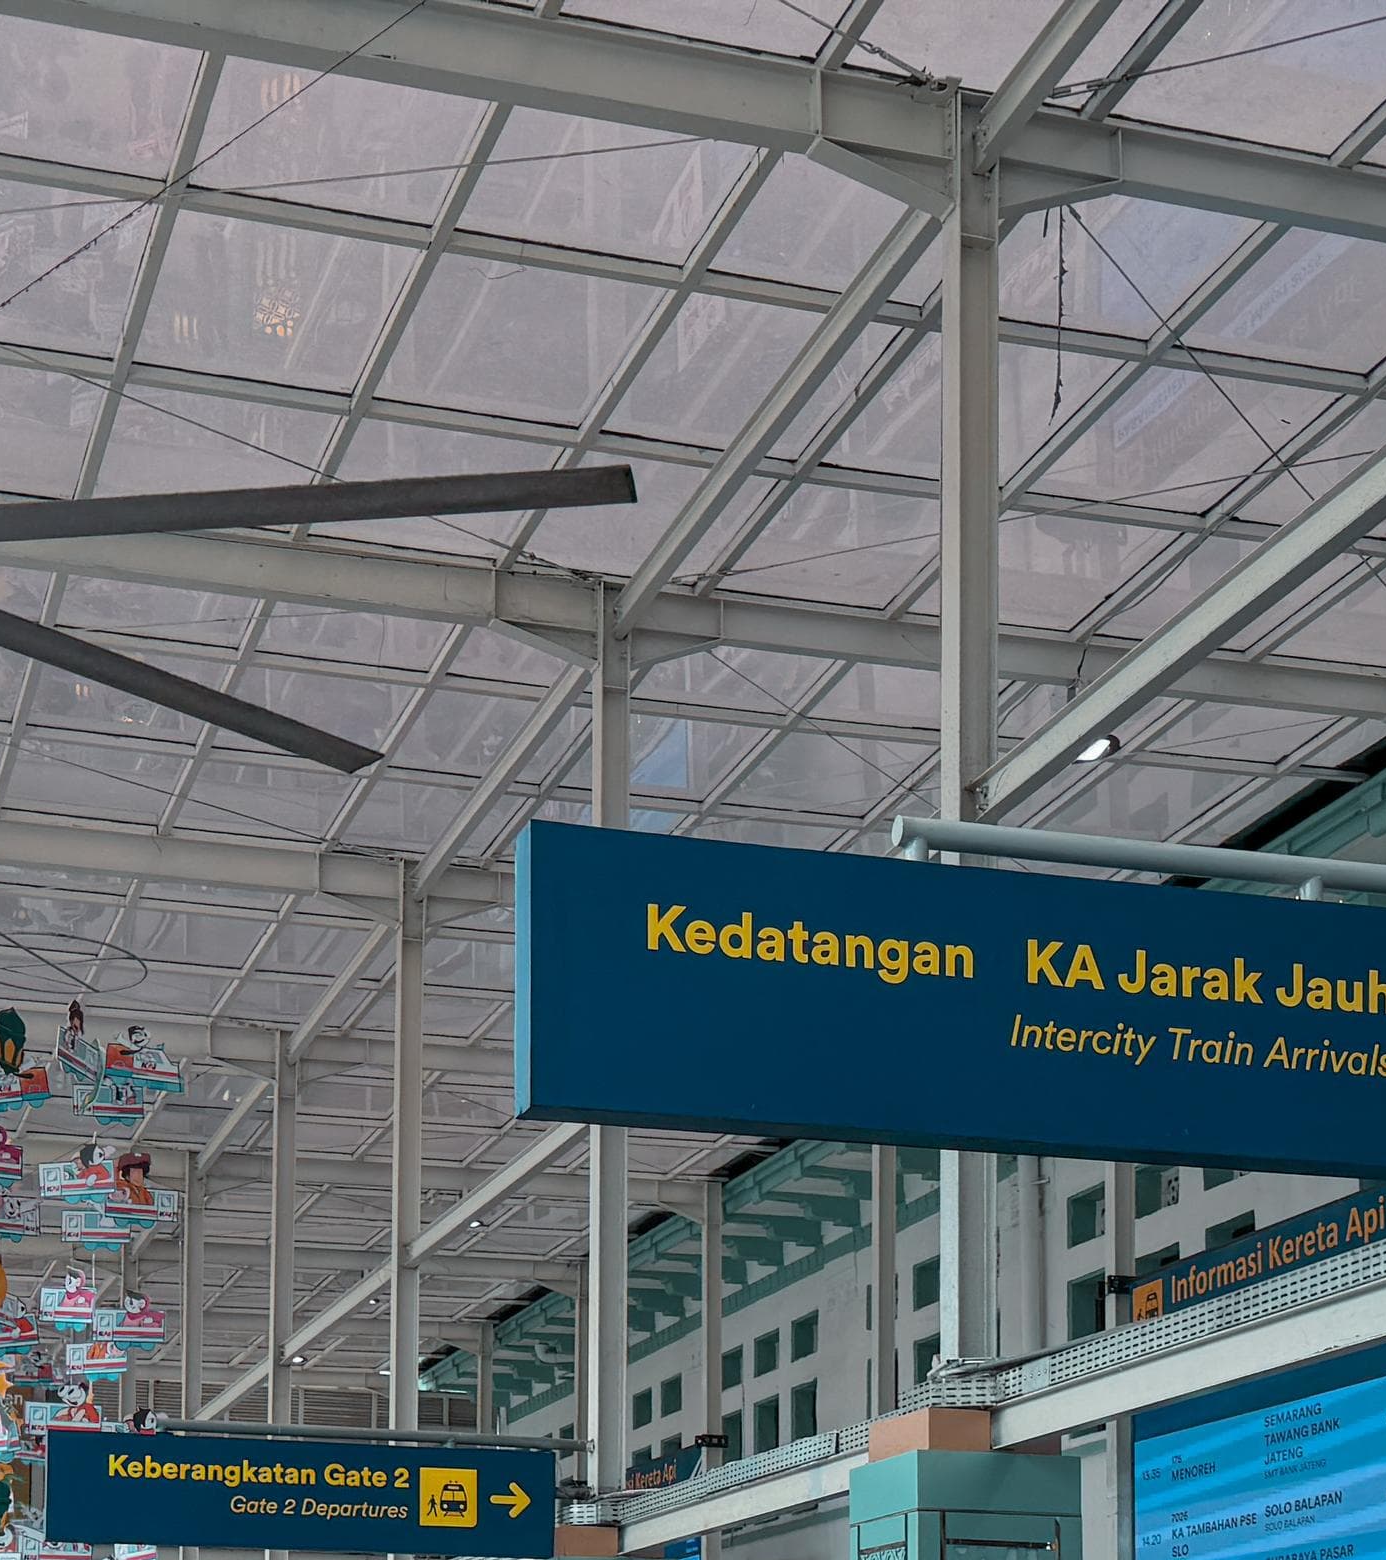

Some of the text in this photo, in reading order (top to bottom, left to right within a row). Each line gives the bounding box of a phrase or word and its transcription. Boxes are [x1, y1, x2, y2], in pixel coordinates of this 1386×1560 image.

[647, 903, 974, 985] Kedatangan
[1027, 939, 1105, 990] KA
[1117, 949, 1263, 1004] Jarak
[1011, 1014, 1157, 1065] Intercity
[1168, 1027, 1254, 1066] Train
[1171, 1195, 1386, 1304] Informasi Kereta Api
[1264, 1402, 1323, 1429] SEMARANG
[1264, 1416, 1341, 1447] TAWANG BANK
[1264, 1445, 1304, 1466] JATENG
[109, 1454, 410, 1488] Keberangkatan Gate 2
[1171, 1461, 1216, 1481] MENOREH
[231, 1496, 408, 1519] Gate 2 Departures
[1264, 1490, 1343, 1519] SOLO BALAPAN
[1172, 1512, 1258, 1540] KA TAMBAHAN PSE
[1172, 1543, 1189, 1558] SLO
[1319, 1543, 1354, 1560] PASAR
